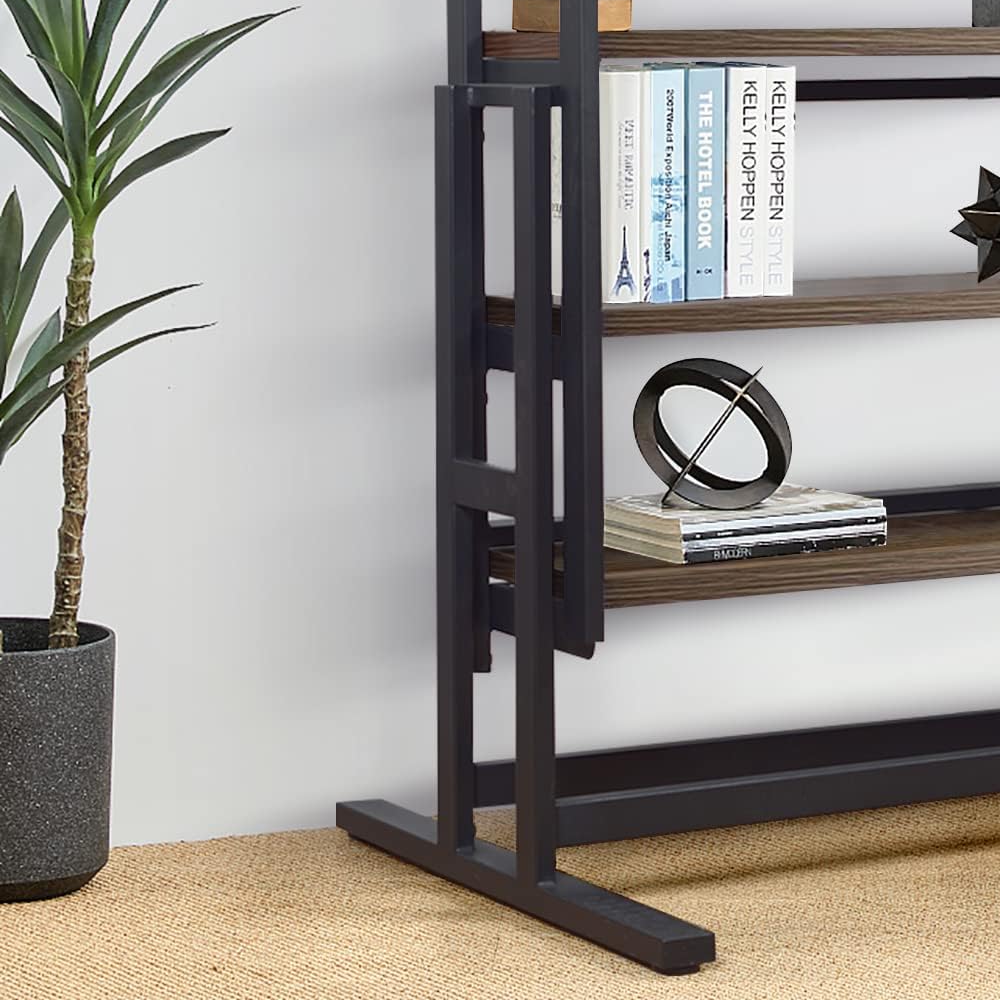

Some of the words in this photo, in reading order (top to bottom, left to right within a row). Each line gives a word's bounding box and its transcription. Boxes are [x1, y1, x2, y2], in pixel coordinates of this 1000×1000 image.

[698, 91, 713, 127] THE
[742, 81, 757, 137] KELLY
[771, 81, 787, 137] KELLY
[664, 146, 673, 199] Exposition
[698, 132, 713, 192] HOTEL
[740, 142, 757, 220] HOPPEN
[769, 142, 786, 220] HOPPEN
[663, 231, 672, 262] Japan
[697, 197, 712, 249] BOOK
[739, 226, 754, 286] STYLE
[768, 226, 783, 285] STYLE
